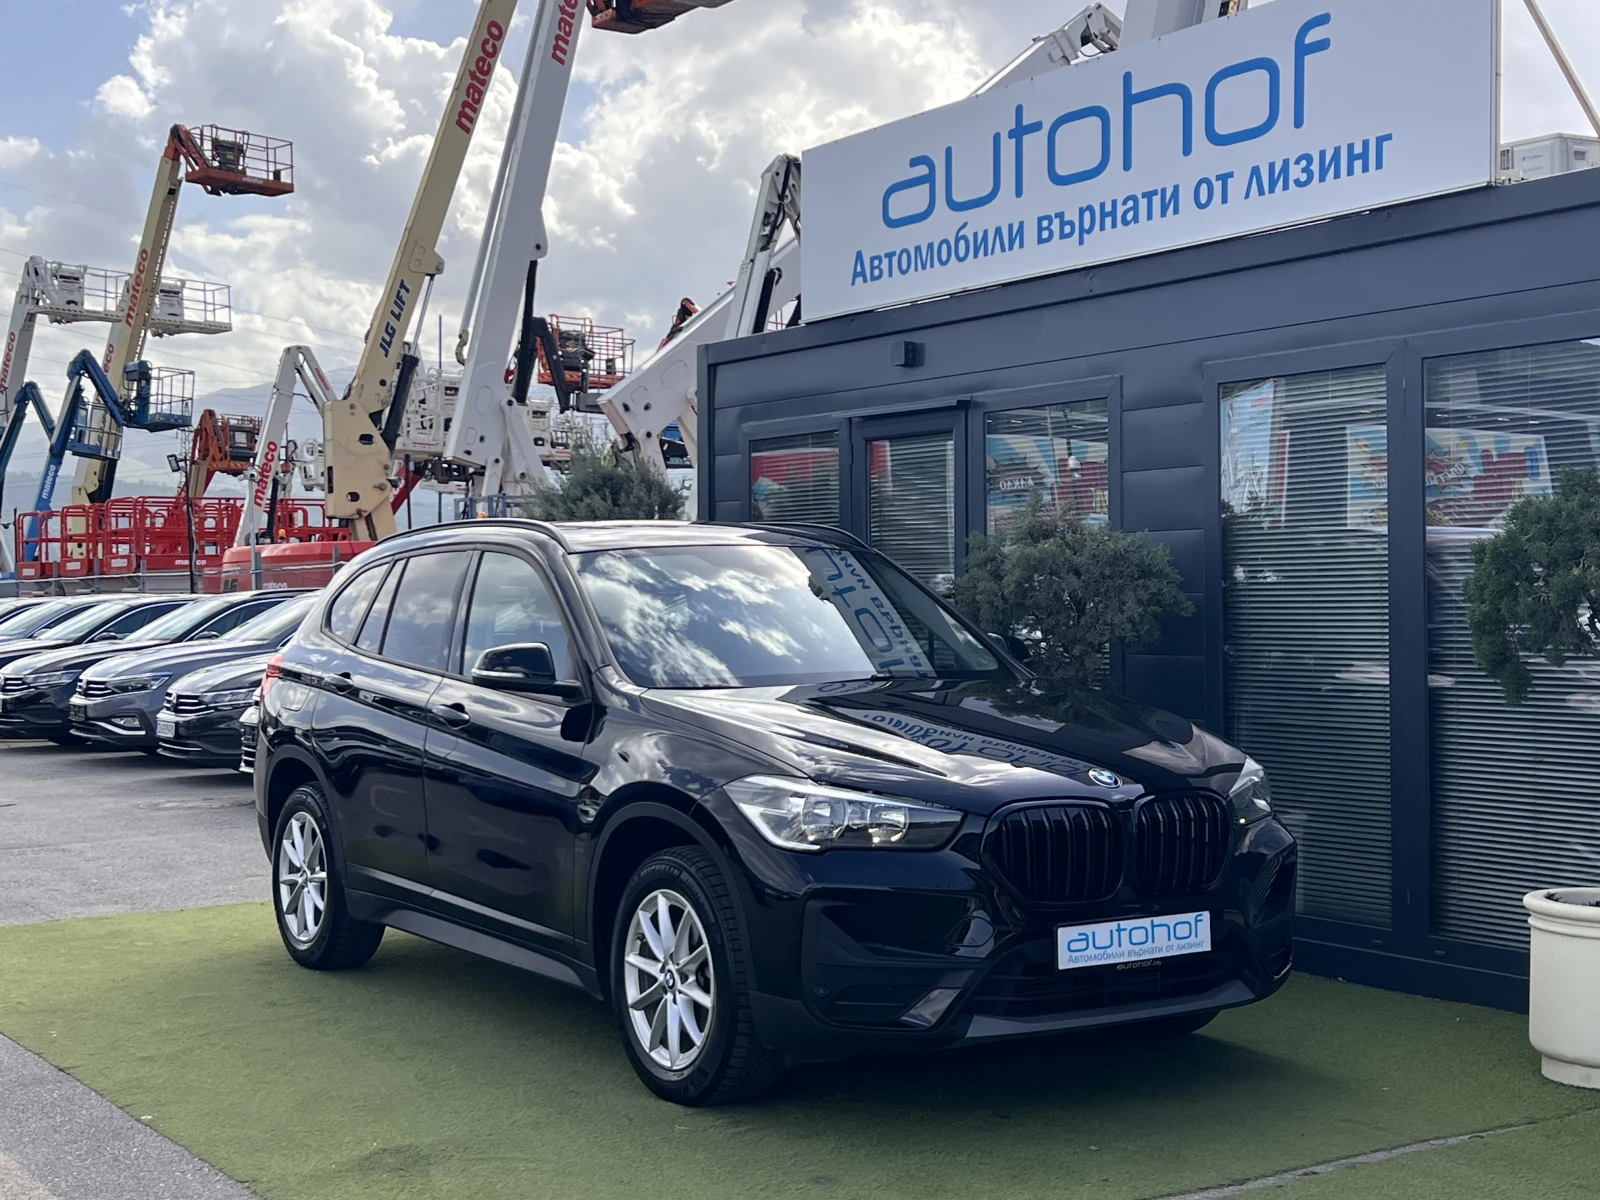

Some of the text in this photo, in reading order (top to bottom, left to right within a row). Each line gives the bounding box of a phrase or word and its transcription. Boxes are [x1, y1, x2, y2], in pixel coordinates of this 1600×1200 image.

[455, 20, 504, 135] mateco
[882, 12, 1331, 229] autohof
[850, 133, 1393, 286] Автомобили върнати от лизинг
[125, 248, 149, 328] mateco
[379, 278, 411, 358] JLG LIFT
[314, 367, 330, 391] mateco
[41, 464, 56, 500] mateco
[253, 440, 278, 508] mateco
[174, 558, 207, 566] maco
[1067, 913, 1203, 952] autohof
[1068, 940, 1205, 965] Автомобили върнати от лизинг
